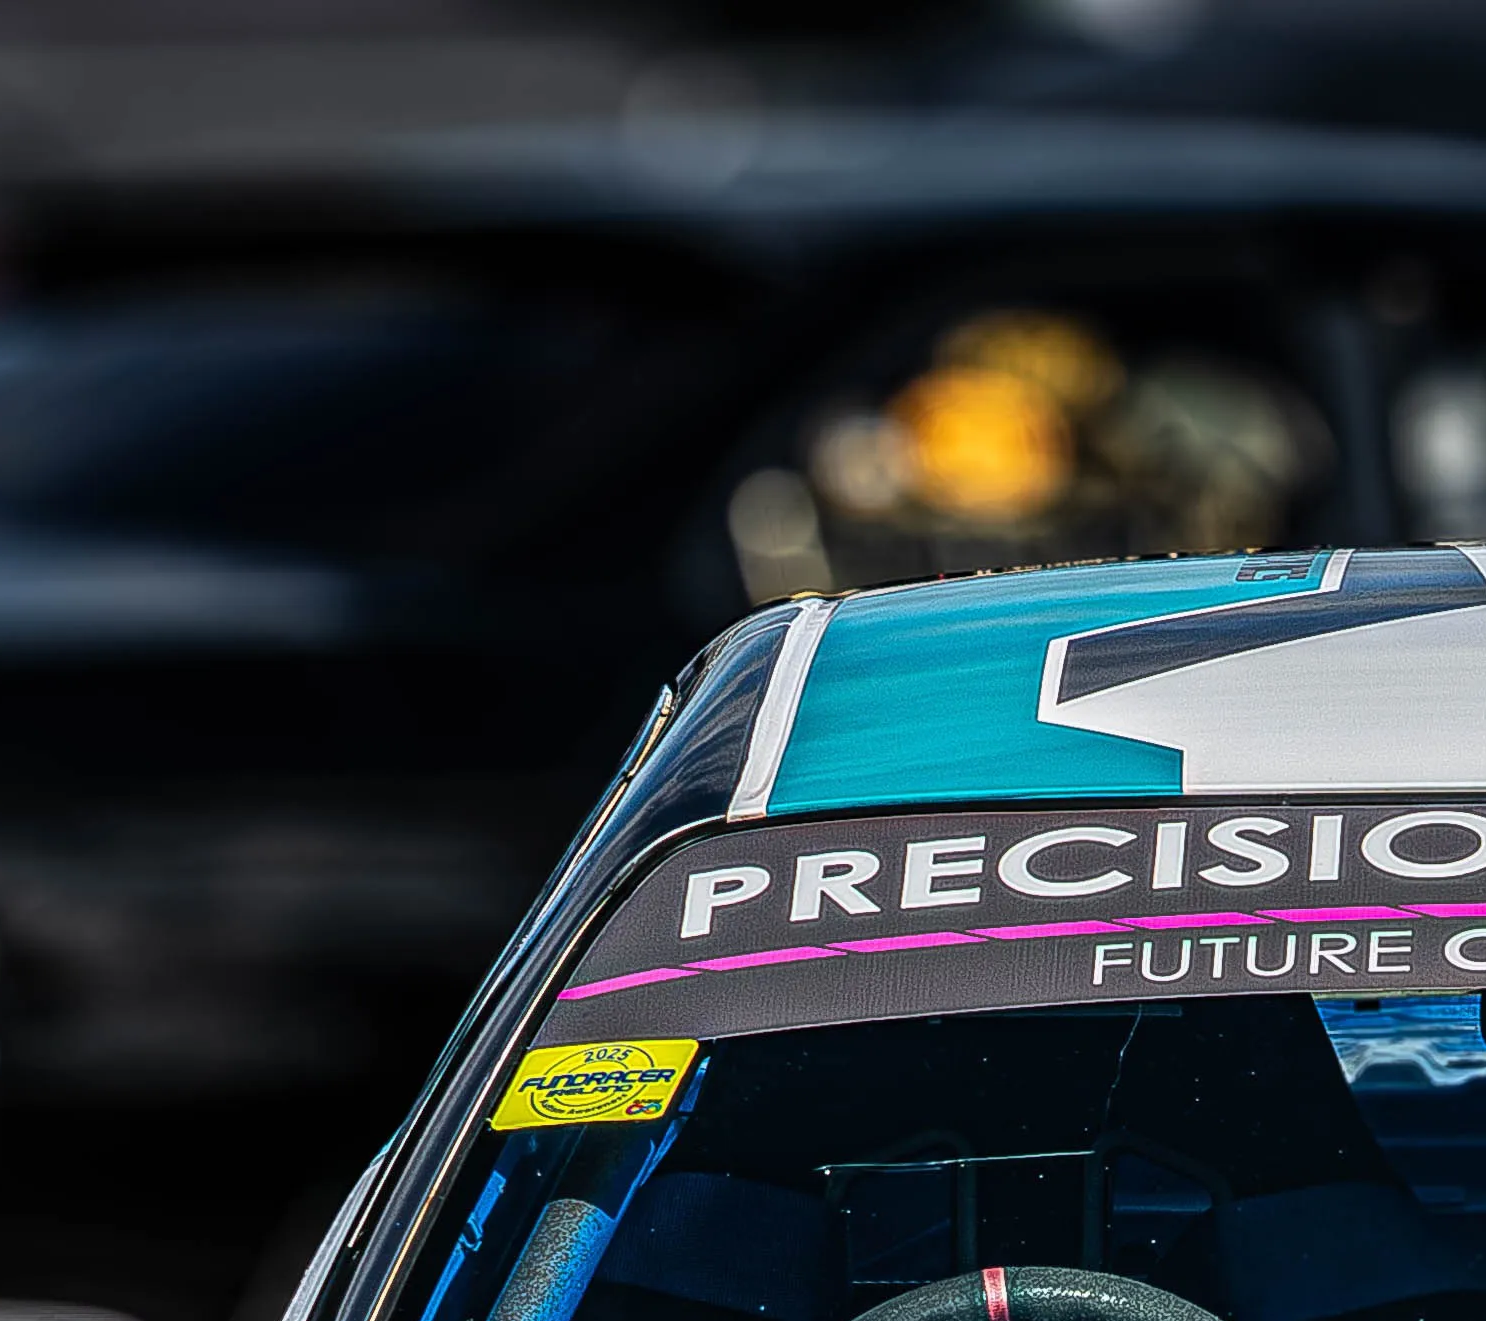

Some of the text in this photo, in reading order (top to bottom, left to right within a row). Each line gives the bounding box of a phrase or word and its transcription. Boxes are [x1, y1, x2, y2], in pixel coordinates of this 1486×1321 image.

[1091, 930, 1414, 986] FUTURE
[584, 1048, 632, 1063] 2025
[518, 1069, 676, 1093] FUNDRACER
